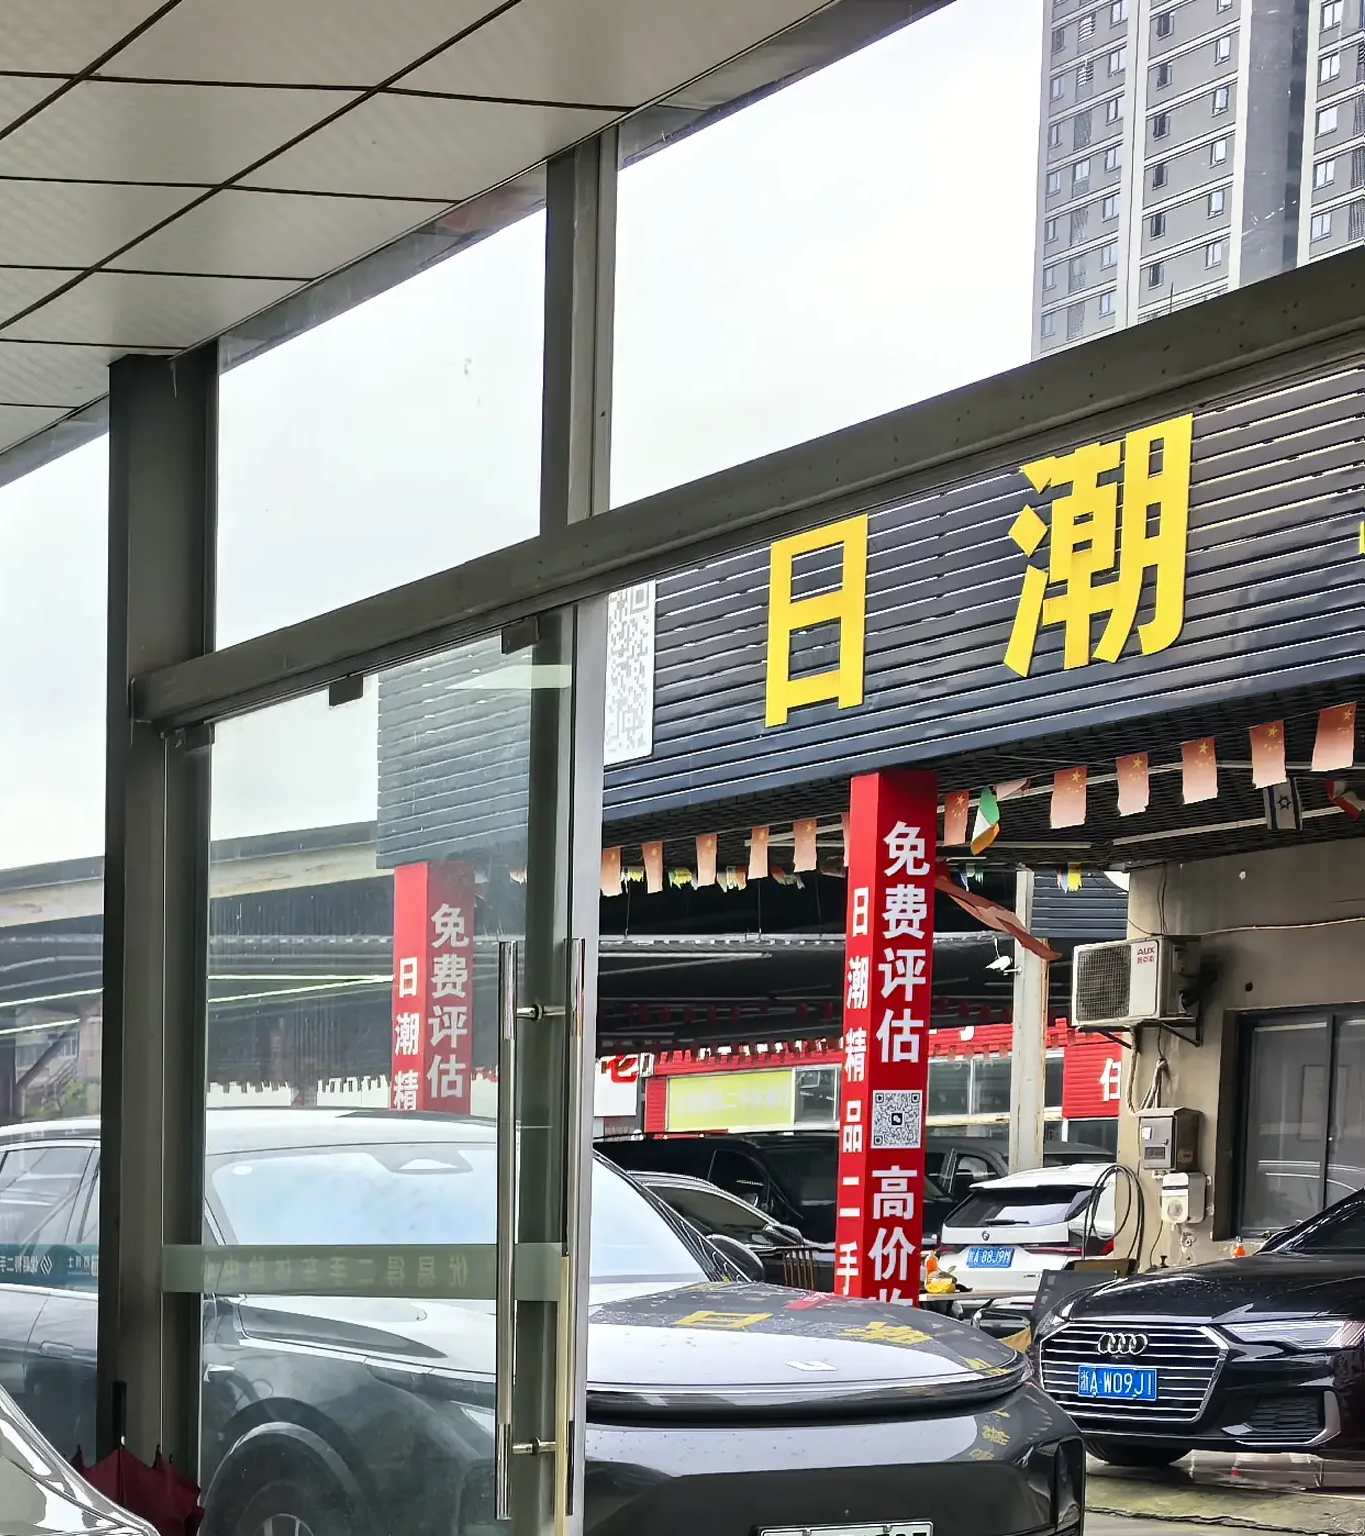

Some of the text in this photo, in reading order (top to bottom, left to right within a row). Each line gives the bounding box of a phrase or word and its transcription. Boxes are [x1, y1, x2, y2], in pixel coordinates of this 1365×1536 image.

[393, 956, 420, 1111] 日潮精
[427, 903, 469, 1098] 免费评估
[1137, 946, 1155, 956] AUX
[836, 887, 870, 1296] 日潮精品二手
[868, 821, 930, 1306] 免费评估 高价
